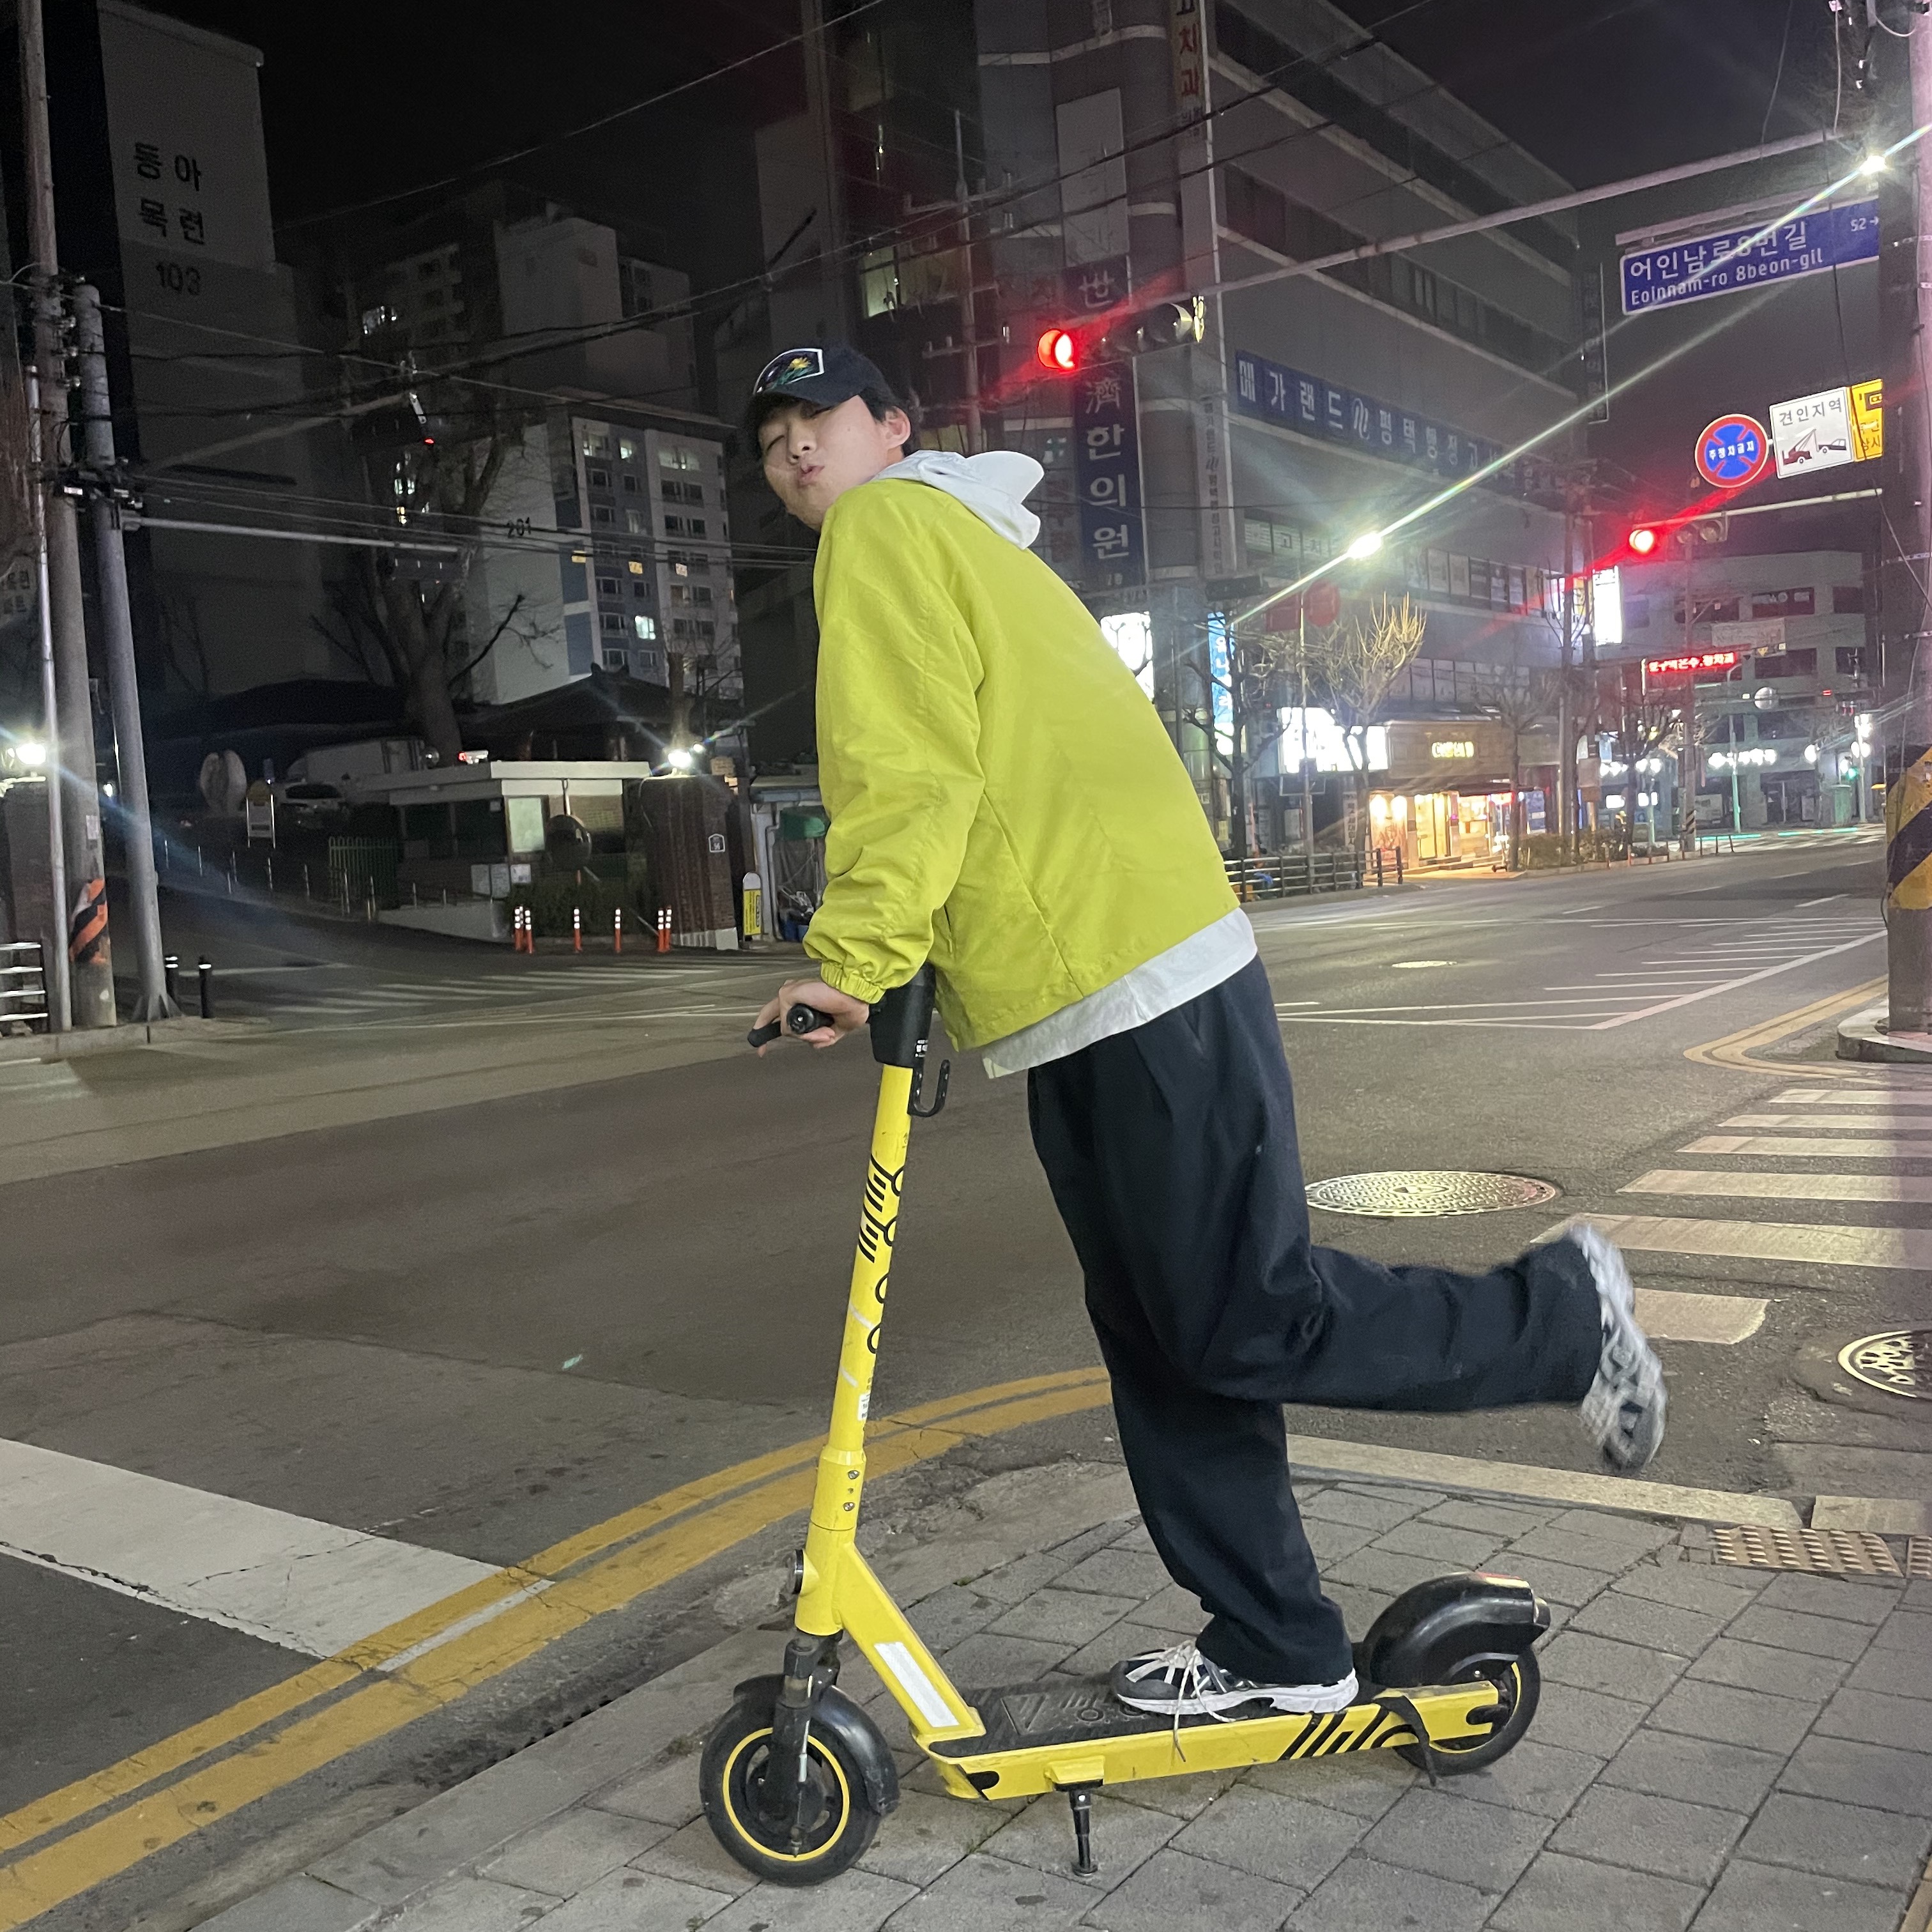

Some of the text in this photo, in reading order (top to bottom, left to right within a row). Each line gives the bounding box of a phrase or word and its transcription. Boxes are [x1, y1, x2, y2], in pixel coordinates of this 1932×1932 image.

[134, 142, 201, 192] 동아
[139, 199, 204, 245] 목련
[1630, 220, 1807, 281] 어인남로8번길
[1735, 248, 1823, 281] 8beon-gil
[157, 263, 200, 295] 103
[1239, 360, 1344, 430] 메가랜드
[1779, 397, 1843, 426] 견인지역
[1708, 440, 1755, 461] 주정차금지
